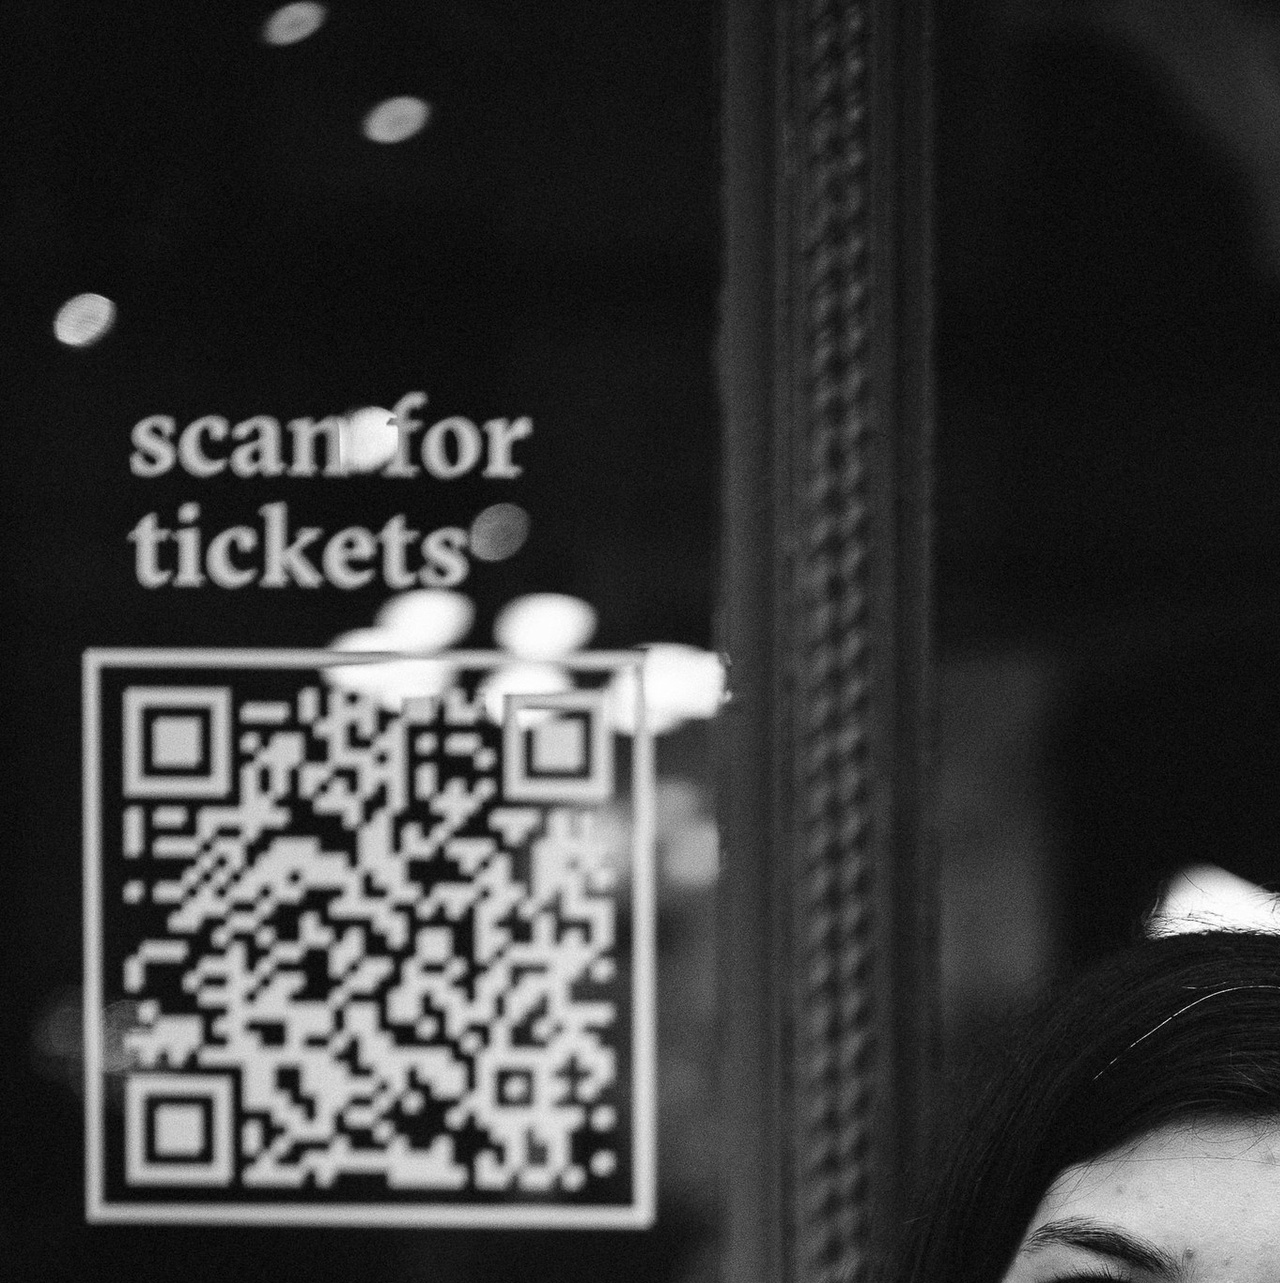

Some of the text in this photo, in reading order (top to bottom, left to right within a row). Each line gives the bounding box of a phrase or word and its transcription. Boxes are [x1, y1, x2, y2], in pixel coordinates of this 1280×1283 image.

[129, 390, 534, 480] scan for
[127, 500, 470, 590] tickets
